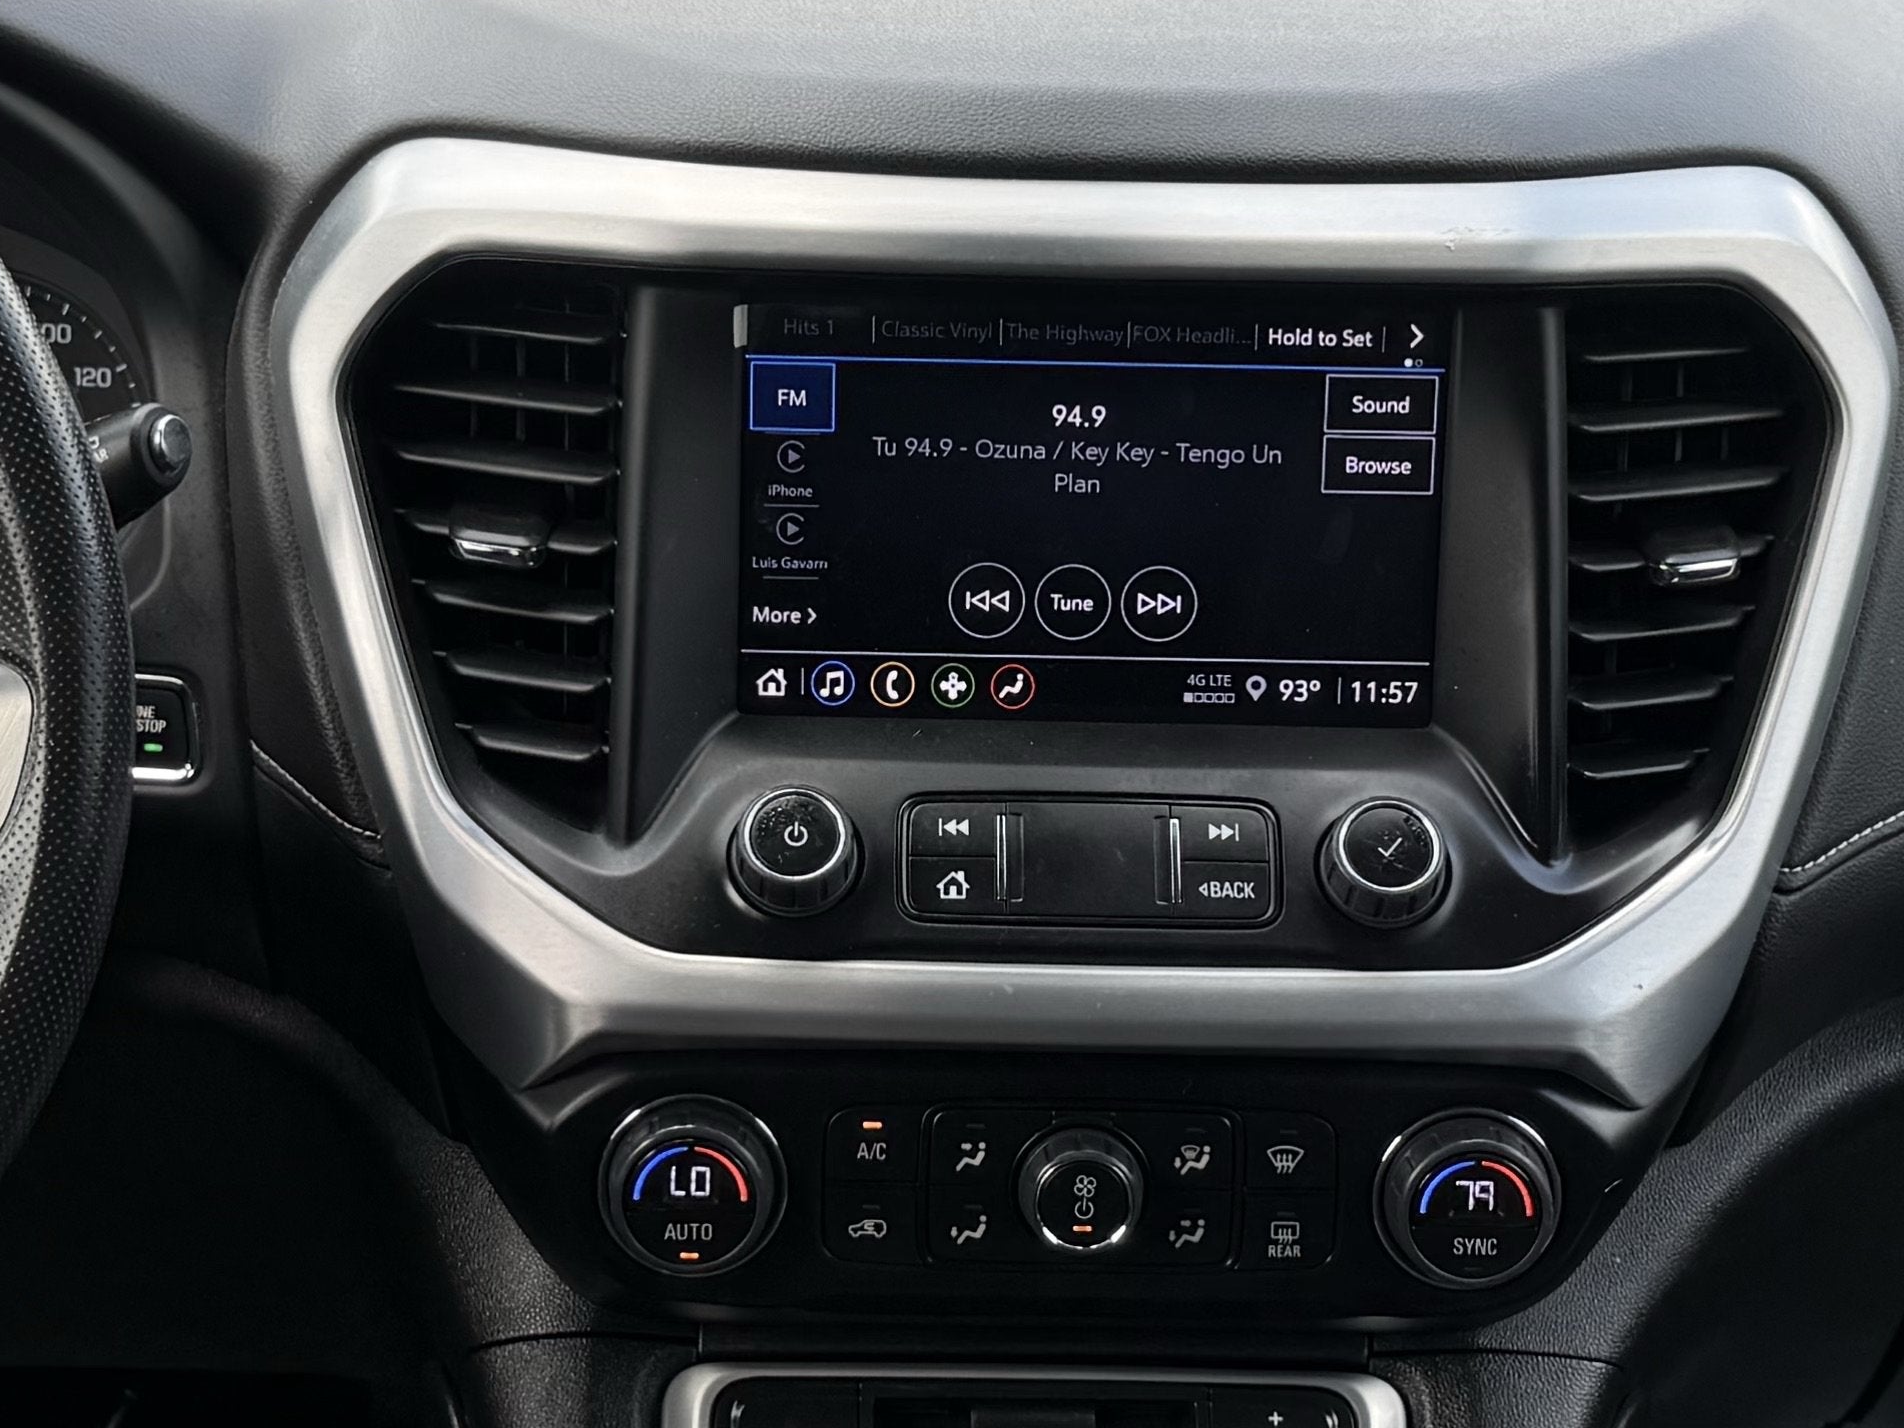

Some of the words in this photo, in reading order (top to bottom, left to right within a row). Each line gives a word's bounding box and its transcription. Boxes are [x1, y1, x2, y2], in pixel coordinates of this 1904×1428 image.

[40, 323, 72, 345] 00
[784, 318, 820, 336] Hits
[882, 320, 945, 339] Classic
[950, 321, 992, 341] Vinyl
[1006, 322, 1040, 341] The
[1046, 323, 1124, 346] Highway
[1133, 326, 1172, 343] FOX
[1269, 328, 1313, 347] Hold
[1318, 330, 1338, 347] to
[1342, 329, 1373, 348] Set
[75, 366, 113, 389] 120
[777, 389, 807, 407] FM
[1352, 396, 1411, 414] Sound
[1052, 405, 1107, 428] 94.9
[872, 437, 896, 458] Tu
[904, 438, 953, 458] 94.9
[975, 439, 1046, 460] Ozuna
[1071, 441, 1109, 467] Key
[1116, 442, 1155, 468] Key
[1176, 443, 1246, 469] Tengo
[1252, 445, 1282, 465] Un
[1346, 457, 1412, 475] Browse
[768, 484, 813, 498] iPhone
[1054, 473, 1101, 494] Plan
[751, 556, 778, 570] Luis
[1050, 594, 1094, 612] Tune
[752, 606, 802, 624] More
[1187, 674, 1206, 687] 4G
[1210, 675, 1232, 687] LTE
[1351, 681, 1418, 704] 11:57
[1209, 879, 1255, 900] BACK
[857, 1141, 887, 1161] A/C
[664, 1223, 713, 1241] AUTO
[1268, 1243, 1302, 1258] REAR
[1452, 1237, 1498, 1256] SYNC
